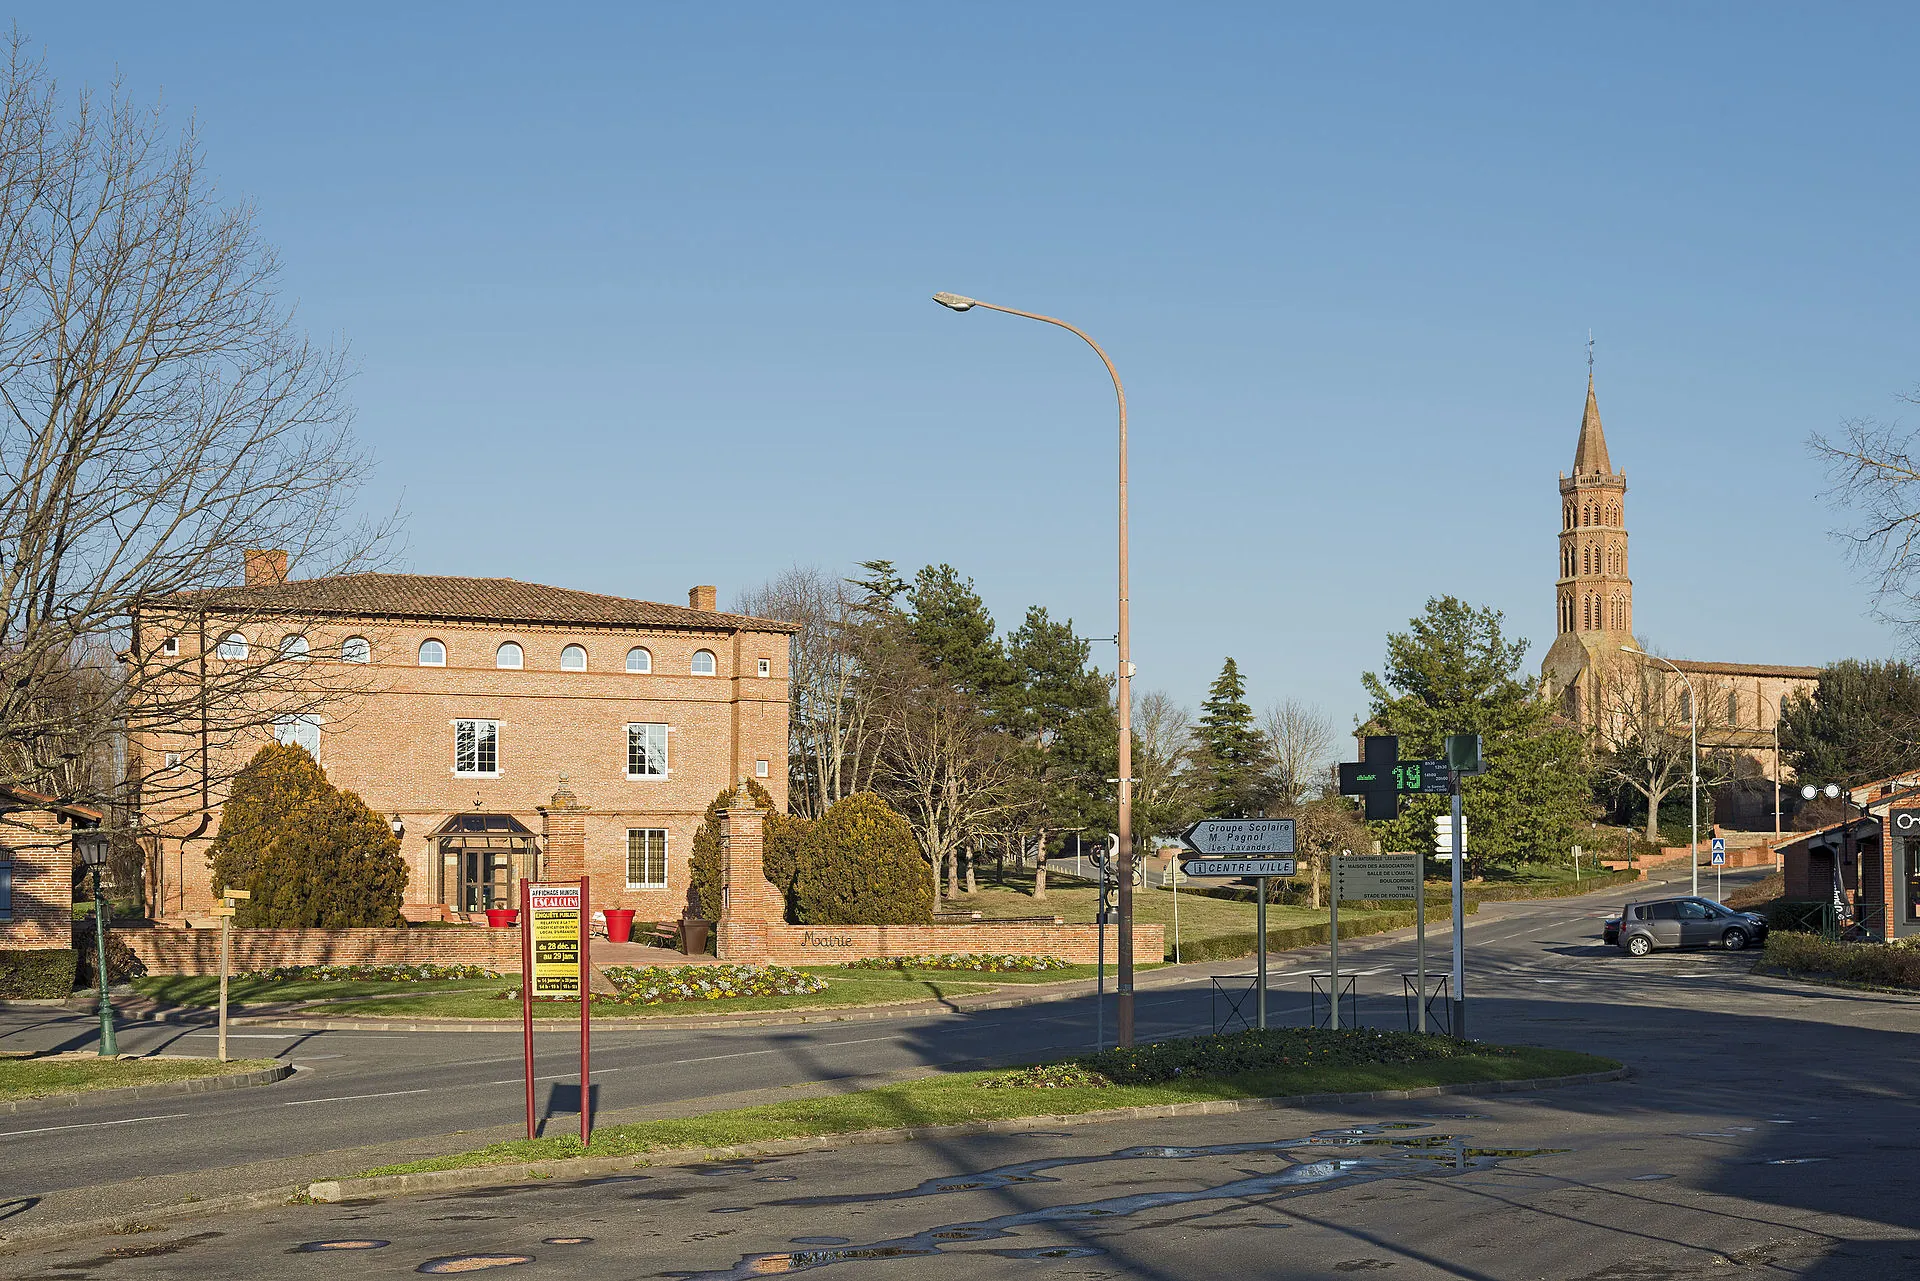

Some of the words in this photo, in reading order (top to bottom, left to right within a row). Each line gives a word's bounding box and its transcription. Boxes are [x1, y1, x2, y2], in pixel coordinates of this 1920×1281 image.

[1392, 765, 1420, 789] 19
[1208, 823, 1243, 833] Groupe
[1248, 823, 1290, 832] Scolaire
[1227, 833, 1264, 843] Pagnol
[1231, 843, 1275, 851] Lavandes)
[1208, 864, 1252, 872] CENTRE
[1260, 863, 1290, 871] VILLE
[801, 931, 853, 947] Mairie
